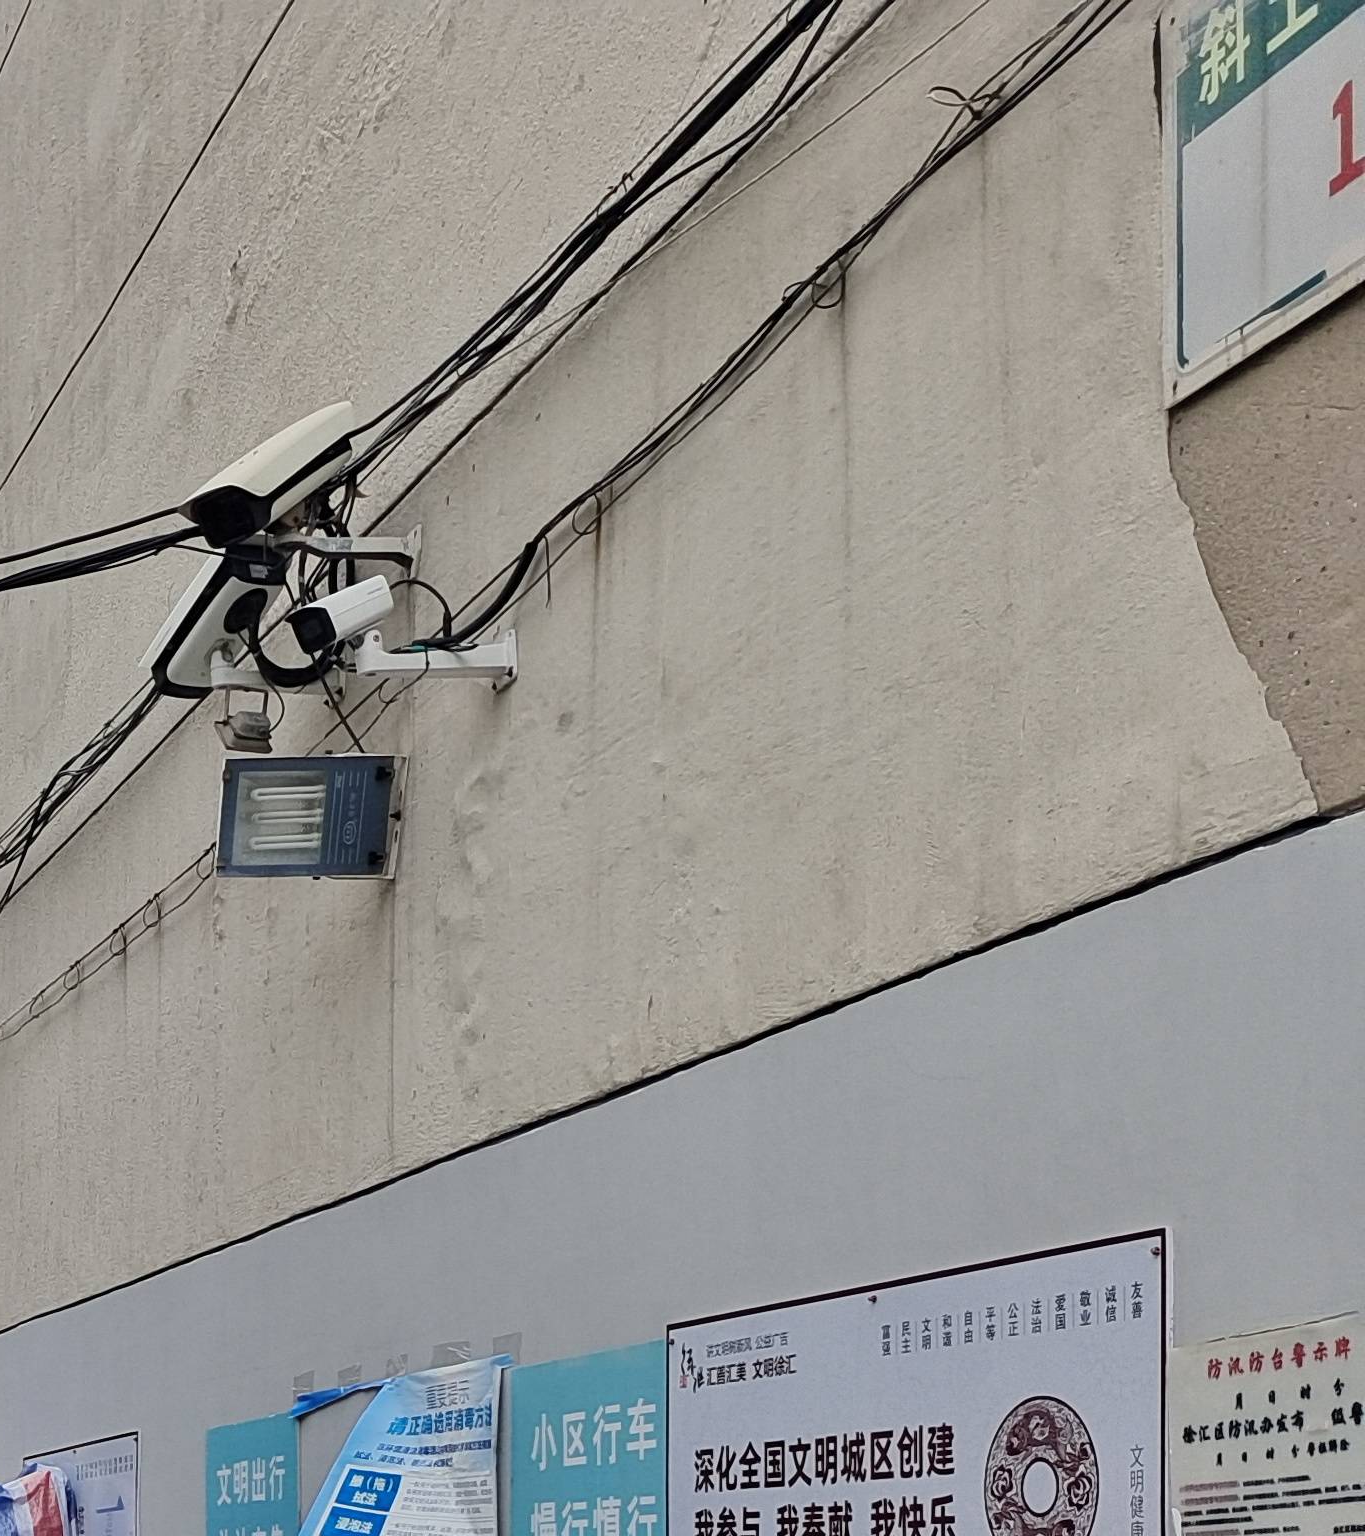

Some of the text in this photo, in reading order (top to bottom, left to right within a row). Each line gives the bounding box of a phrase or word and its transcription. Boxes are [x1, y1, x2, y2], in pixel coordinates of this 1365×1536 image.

[752, 1354, 797, 1381] 文明徐汇
[1208, 1336, 1351, 1380] 防汛防台警示牌
[531, 1398, 657, 1471] 小区行车
[1182, 1410, 1305, 1444] 徐汇区防汛办发布
[694, 1422, 955, 1493] 深化全国文明城区创建
[216, 1455, 286, 1507] 文明出行
[334, 1516, 374, 1535] 浸泡法
